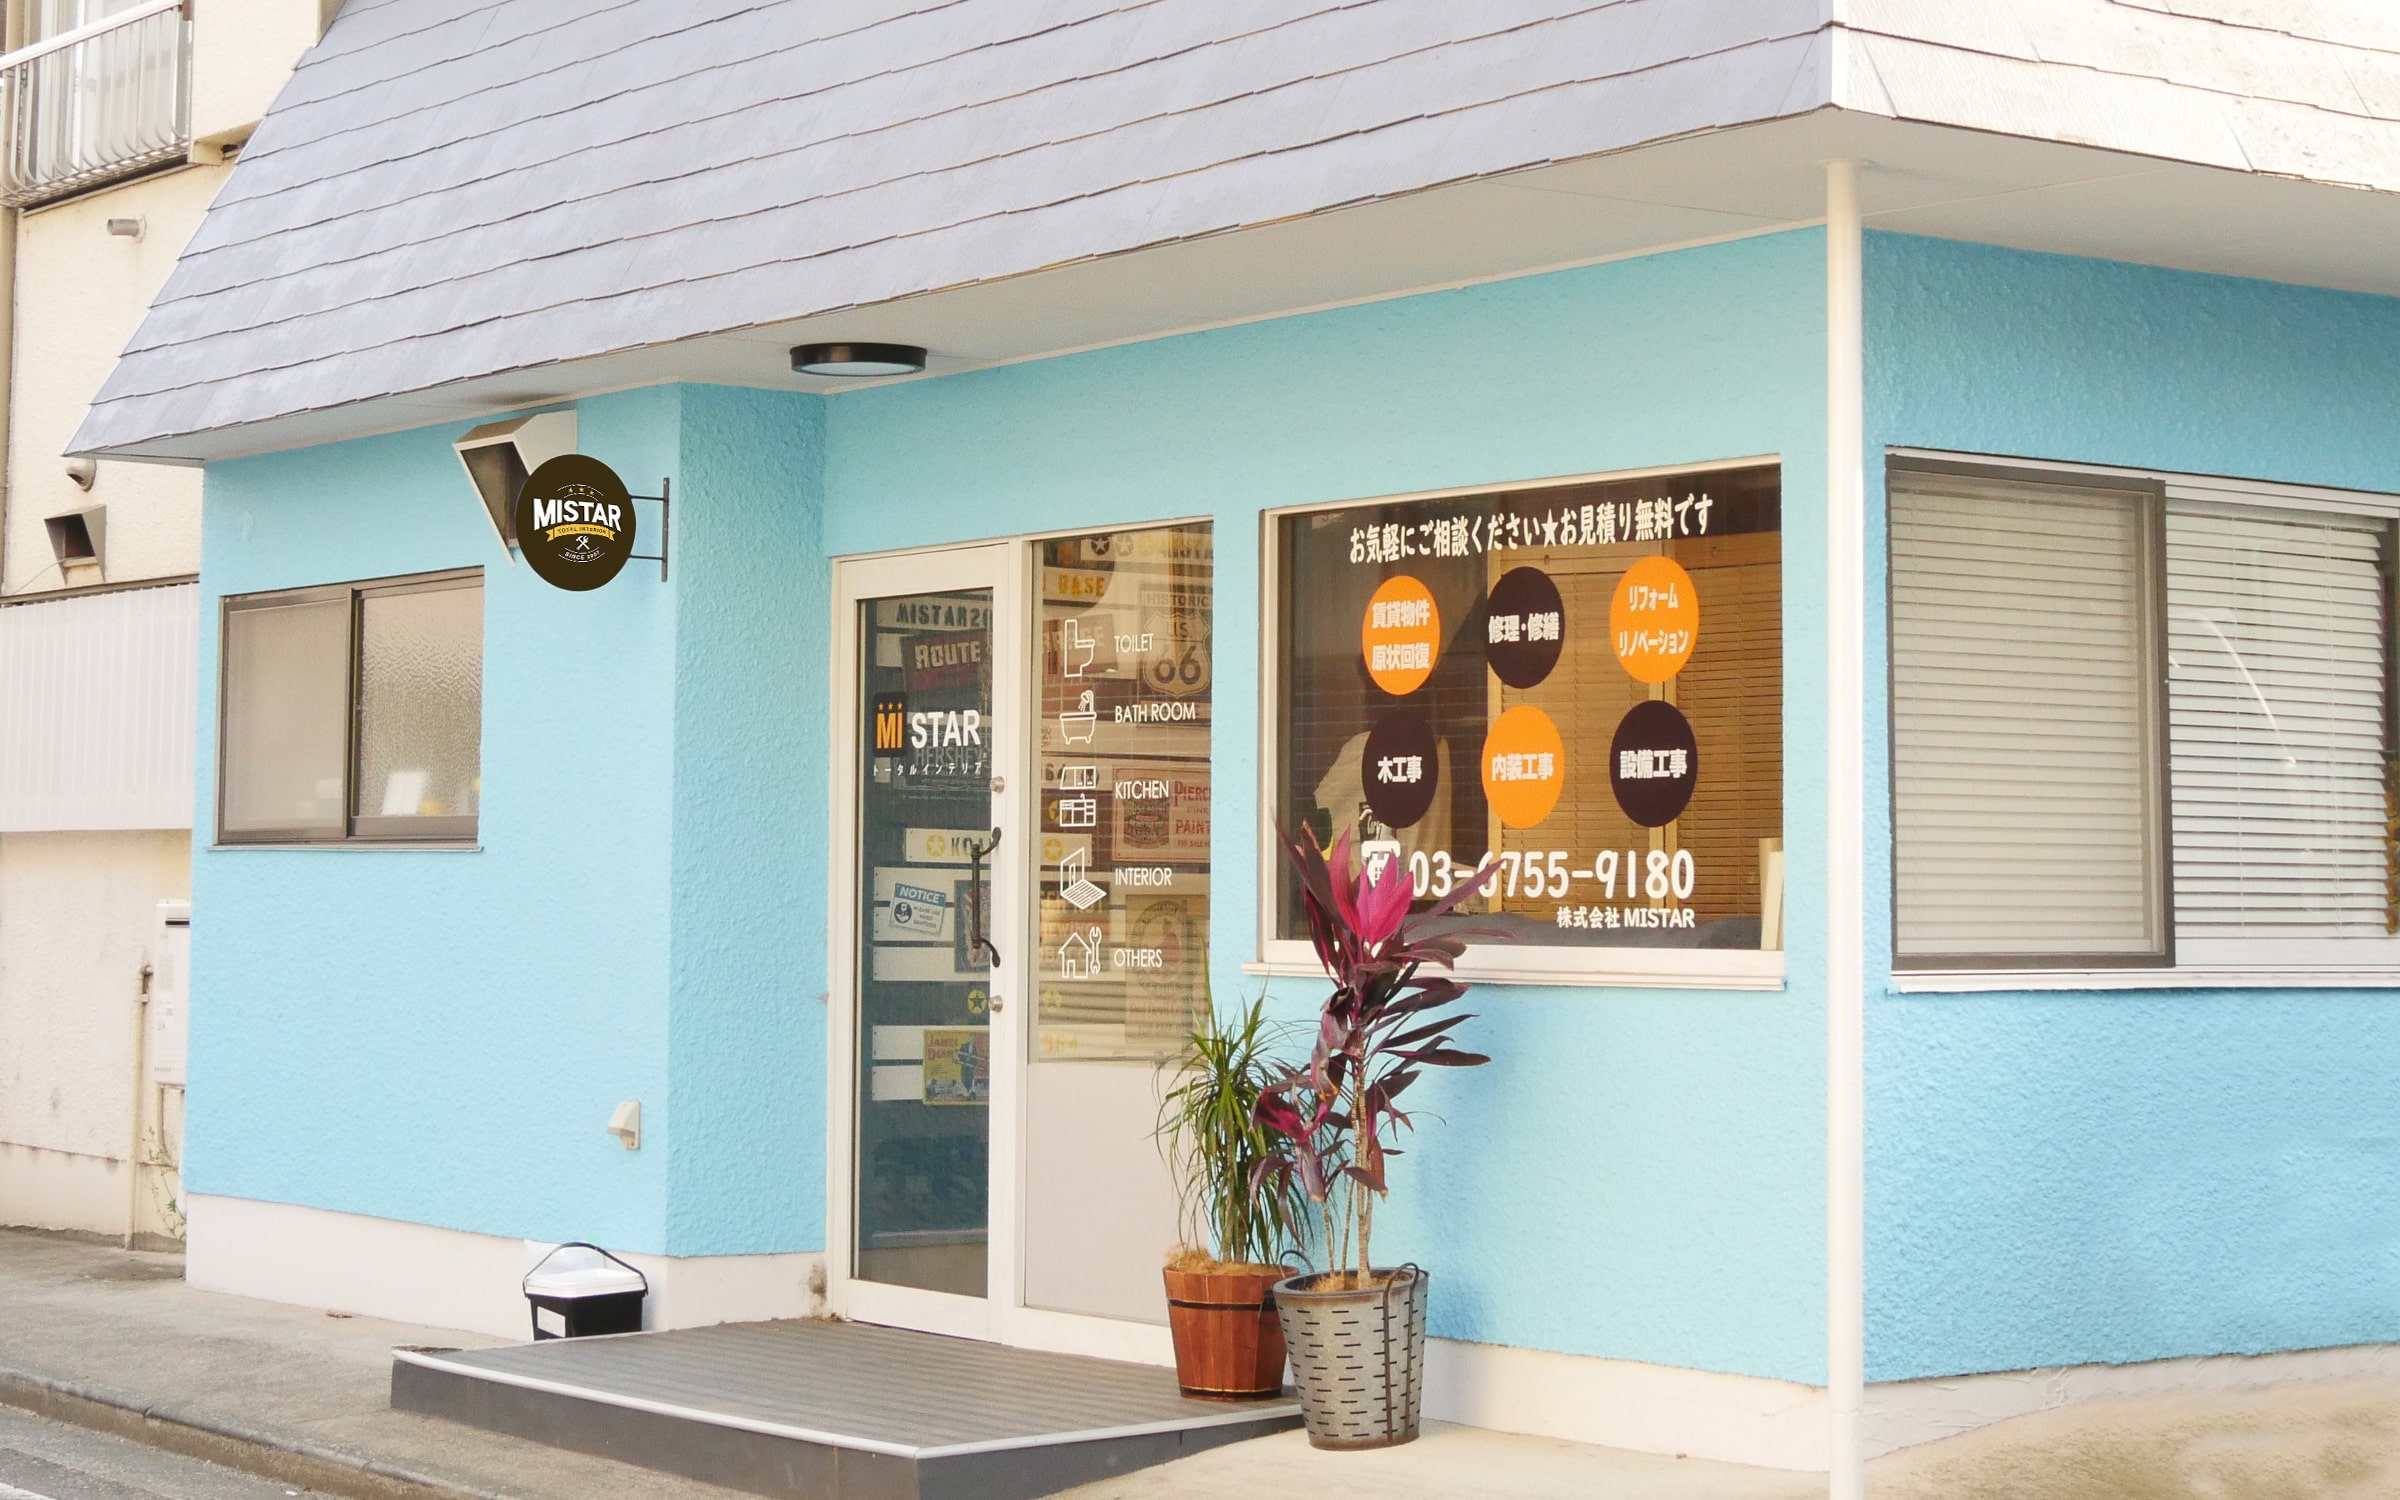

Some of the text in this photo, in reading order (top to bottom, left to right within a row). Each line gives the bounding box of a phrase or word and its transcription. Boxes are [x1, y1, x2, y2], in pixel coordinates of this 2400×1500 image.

[533, 498, 622, 532] MISTAR
[557, 526, 607, 534] TOTAL INTERIOR
[564, 551, 585, 560] SINCE
[1146, 593, 1209, 608] HISTORIC
[1629, 583, 1679, 612] リフォーム
[1372, 599, 1431, 629] 賃貸物件
[1488, 612, 1560, 643] 修理・修繕
[914, 641, 980, 669] ROUTE
[1114, 633, 1154, 653] TOILET
[1372, 642, 1431, 671] 原状回復
[1619, 629, 1689, 657] リノベーション
[1154, 645, 1202, 686] 66
[1115, 702, 1196, 724] BATH ROOM
[876, 709, 981, 749] MI STAR
[873, 762, 982, 776] トータルインテリア
[1377, 755, 1422, 783] 木工事
[1491, 752, 1554, 781] 内装工事
[1619, 748, 1687, 779] 設備工事
[1115, 780, 1169, 799] KITCHEN
[1115, 868, 1172, 886] INTERIOR
[1408, 849, 1694, 899] 03-6755-9180
[899, 885, 941, 904] NOTICE
[1556, 906, 1695, 928] 株式会社 MISTAR
[1114, 949, 1163, 968] OTHERS
